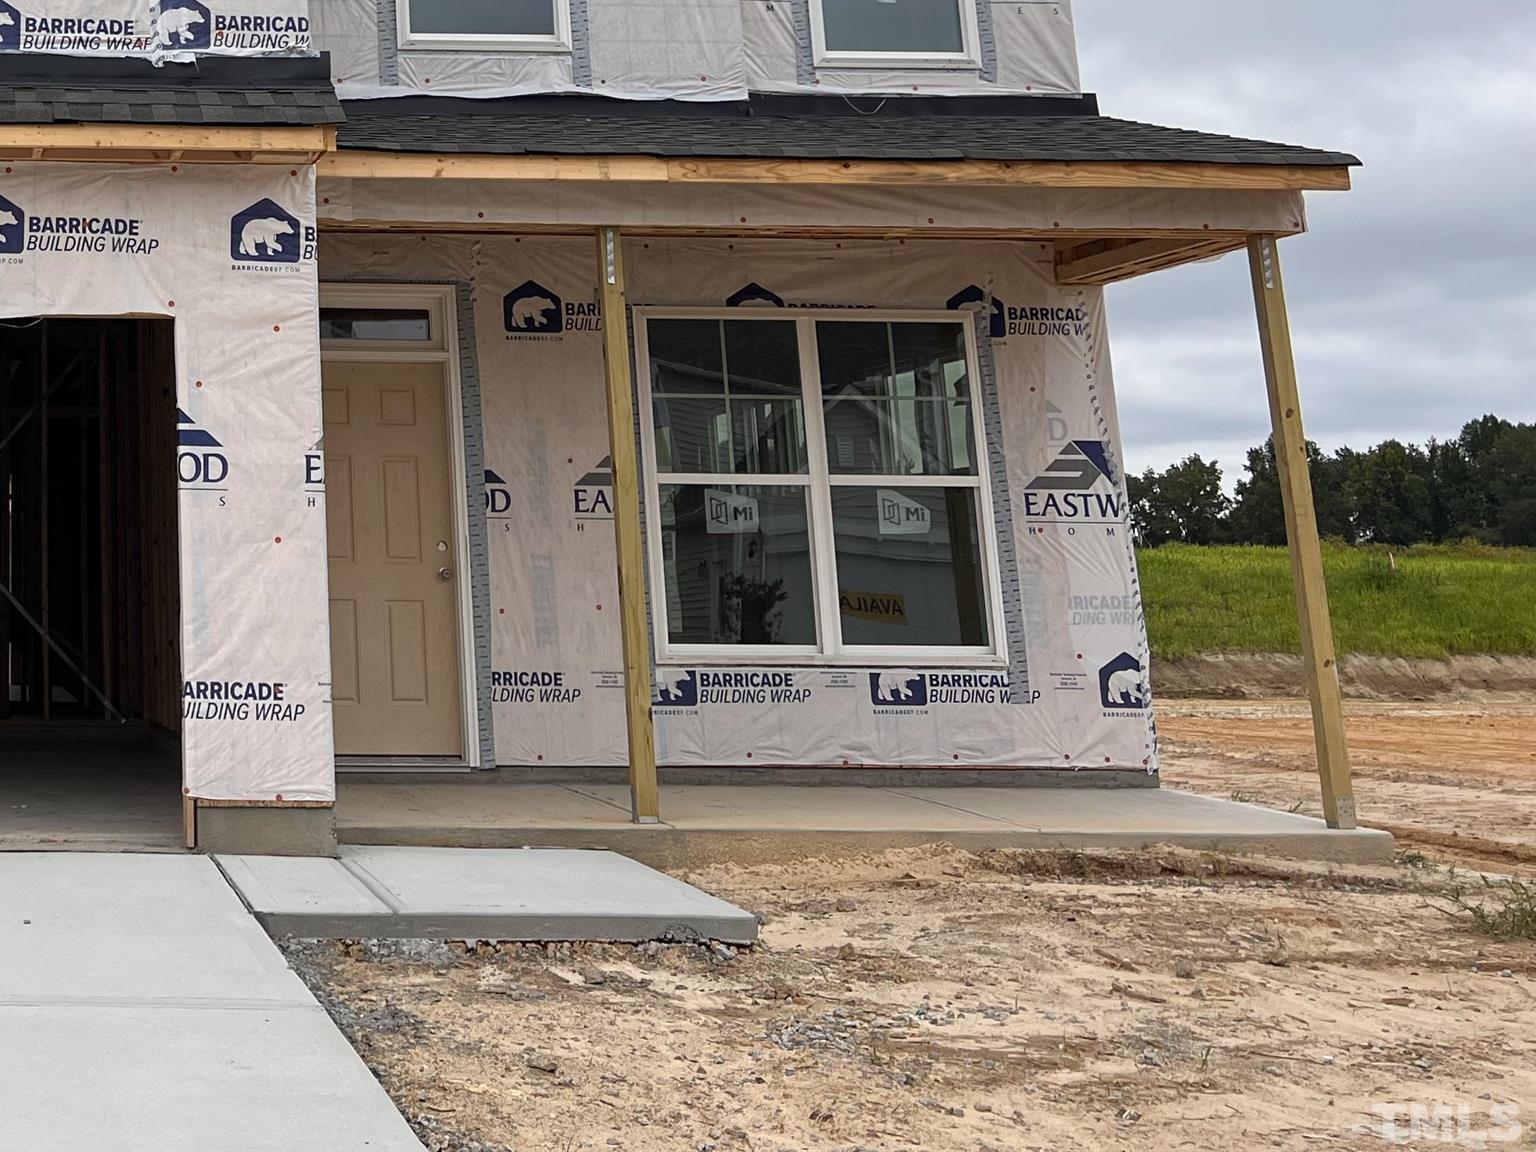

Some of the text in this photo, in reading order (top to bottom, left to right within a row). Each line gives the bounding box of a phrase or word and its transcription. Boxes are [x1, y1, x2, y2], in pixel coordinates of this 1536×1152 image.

[26, 18, 135, 35] BARRICADE
[215, 15, 308, 32] BARRICAD
[23, 35, 151, 51] BUILDING WRAP
[214, 34, 288, 48] BUILDING
[29, 216, 139, 236] BARRICADE
[27, 236, 158, 254] BUILDING WRAP
[1008, 322, 1070, 336] BUILDING
[734, 508, 753, 521] Mi
[906, 508, 925, 521] Mi
[492, 672, 563, 687] RRICADE
[701, 673, 793, 687] BARRICADE
[492, 689, 580, 702] LDING WRAP
[700, 689, 810, 704] BUILDING WRAP
[930, 689, 995, 703] BUILDING
[256, 704, 304, 721] WRAP
